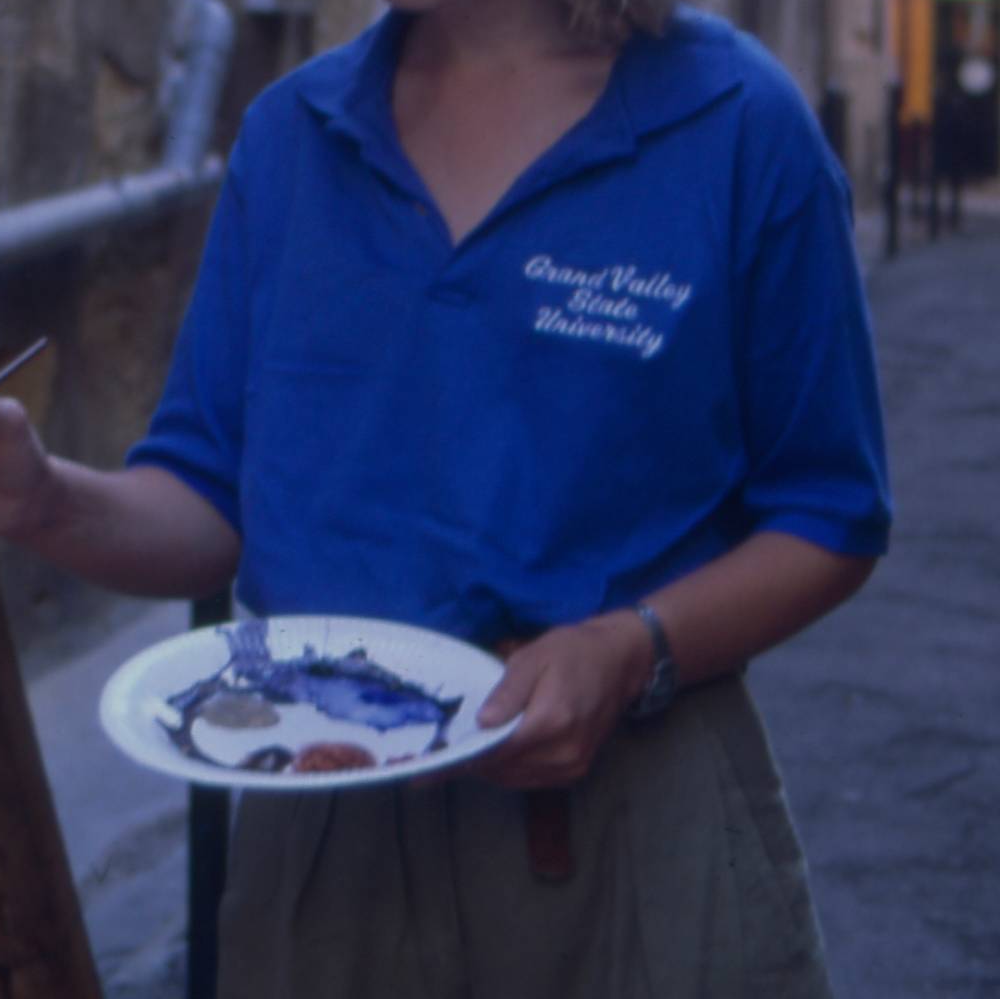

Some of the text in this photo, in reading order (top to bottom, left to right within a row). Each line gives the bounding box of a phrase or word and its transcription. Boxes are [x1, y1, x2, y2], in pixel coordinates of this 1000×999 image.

[523, 255, 692, 311] Grand Valley
[566, 288, 639, 320] State
[533, 306, 664, 359] University
